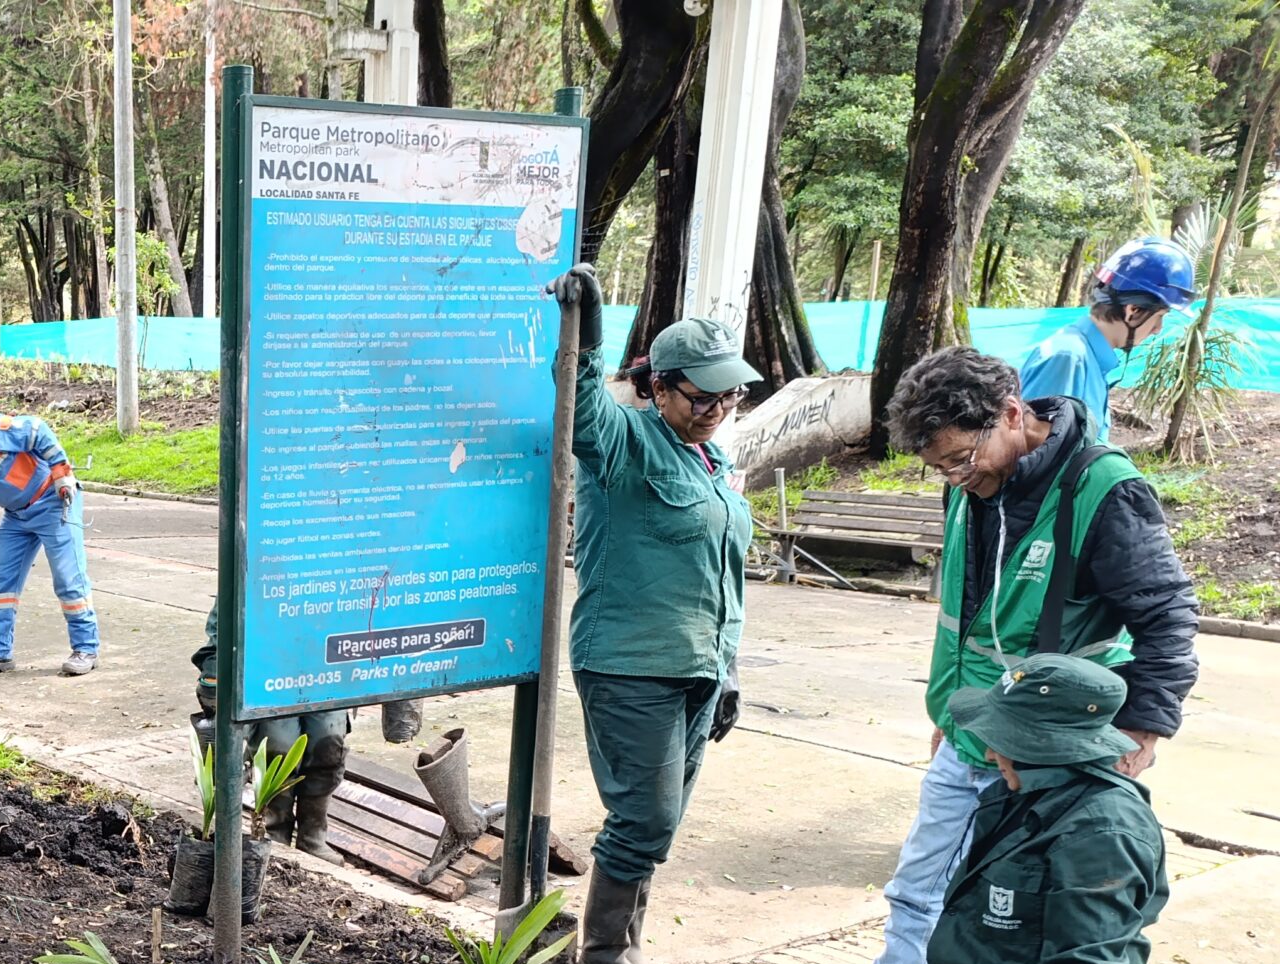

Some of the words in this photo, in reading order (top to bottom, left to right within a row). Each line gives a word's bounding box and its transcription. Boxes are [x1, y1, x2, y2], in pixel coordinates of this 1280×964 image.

[260, 121, 320, 142] Parque
[326, 125, 440, 147] Metropolitano
[260, 141, 332, 156] Metropolitan
[335, 144, 360, 157] park
[259, 159, 378, 183] NACIONAL
[516, 165, 560, 178] MEJOR
[260, 189, 313, 199] LOCALIDAD
[316, 190, 346, 200] SANTA
[348, 192, 359, 200] FE
[267, 212, 312, 225] ESTIMADO
[314, 213, 352, 226] USUARIO
[354, 214, 382, 227] TENGA
[384, 215, 395, 228] EN
[397, 216, 430, 229] CUENTA
[432, 217, 447, 229] LAS
[344, 232, 384, 245] DURANTE
[386, 233, 398, 245] SU
[400, 233, 433, 246] ESTADIA
[435, 234, 446, 246] EN
[448, 234, 458, 246] EL
[310, 254, 317, 262] el
[320, 254, 355, 264] expendio
[357, 256, 361, 264] y
[400, 255, 409, 263] de
[294, 283, 304, 291] de
[264, 293, 303, 301] destinado
[305, 294, 323, 302] para
[325, 293, 332, 301] la
[384, 293, 396, 301] del
[398, 293, 425, 302] deporte
[293, 313, 324, 321] zapatos
[326, 312, 365, 321] deportivos
[368, 312, 408, 320] adecuados
[410, 312, 427, 320] para
[449, 312, 475, 320] deporte
[477, 312, 490, 320] que
[412, 331, 440, 339] espacio
[282, 360, 302, 368] favor
[304, 360, 323, 369] dejar
[275, 370, 308, 378] absoluta
[427, 386, 431, 394] y
[445, 402, 454, 410] los
[291, 426, 302, 434] las
[304, 425, 333, 434] puertas
[419, 422, 435, 430] para
[309, 444, 315, 452] al
[297, 490, 307, 498] de
[260, 500, 301, 509] deportivos
[340, 497, 352, 505] por
[292, 518, 303, 526] los
[355, 513, 364, 521] de
[276, 537, 296, 547] jugar
[332, 533, 355, 541] zonas
[318, 551, 343, 559] ventas
[345, 548, 386, 556] ambulantes
[287, 571, 298, 579] los
[300, 569, 332, 578] residuos
[263, 583, 285, 599] Los
[288, 580, 336, 600] jardines
[339, 581, 346, 595] y
[350, 576, 384, 590] zonas
[388, 571, 426, 587] verdes
[428, 570, 448, 582] son
[451, 567, 476, 583] para
[479, 560, 539, 582] protegerlos,
[279, 602, 300, 617] Por
[303, 600, 333, 616] favor
[337, 597, 379, 612] transite
[383, 594, 402, 610] por
[404, 591, 421, 605] las
[423, 588, 457, 603] zonas
[459, 582, 519, 602] peatonales.
[337, 636, 398, 654] ¡Parques
[401, 632, 431, 649] para
[434, 624, 475, 643] soñar!
[264, 670, 342, 692] COD:03-035
[351, 664, 389, 681] Parks
[392, 663, 406, 677] to
[410, 655, 458, 674] dream!
